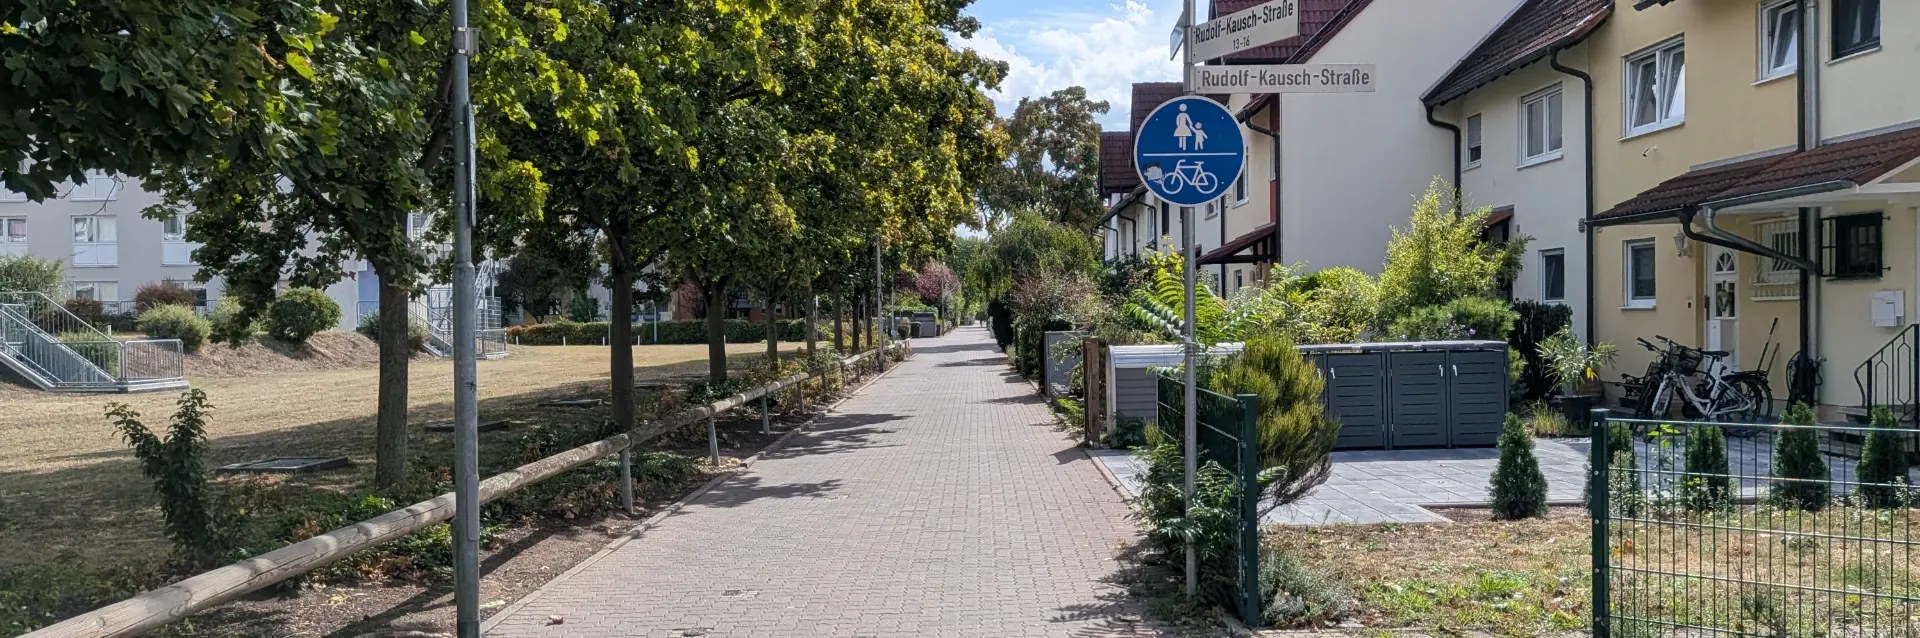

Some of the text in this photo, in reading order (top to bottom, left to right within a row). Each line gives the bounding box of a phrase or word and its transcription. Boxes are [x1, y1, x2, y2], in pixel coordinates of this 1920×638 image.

[1195, 0, 1293, 44] Rudolf-Kausch-Straße
[1232, 35, 1250, 50] 13-16
[1202, 69, 1370, 86] Rudolf-Kausch-Straße
